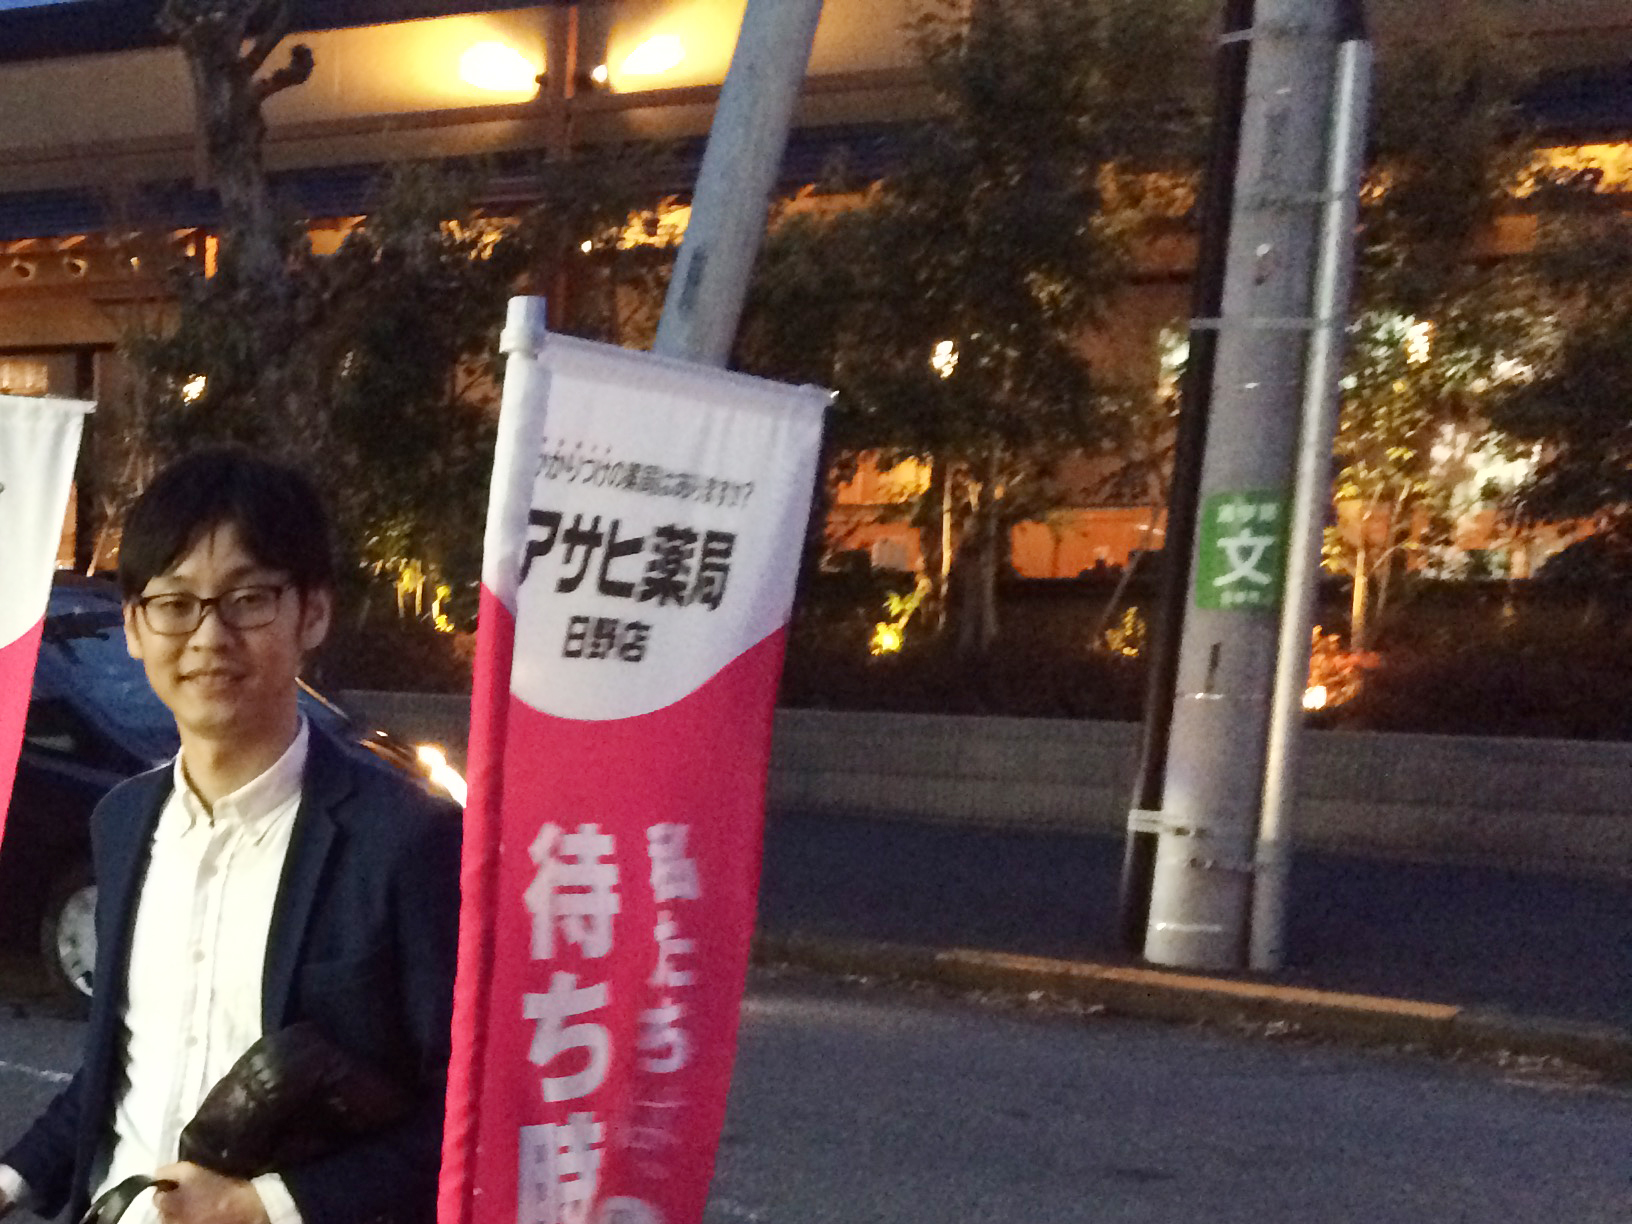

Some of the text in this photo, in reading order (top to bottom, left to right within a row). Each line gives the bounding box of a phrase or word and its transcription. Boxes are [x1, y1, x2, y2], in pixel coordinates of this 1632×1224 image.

[517, 508, 739, 612] アサヒ薬局
[1212, 527, 1276, 587] 文
[562, 614, 653, 663] 日野店
